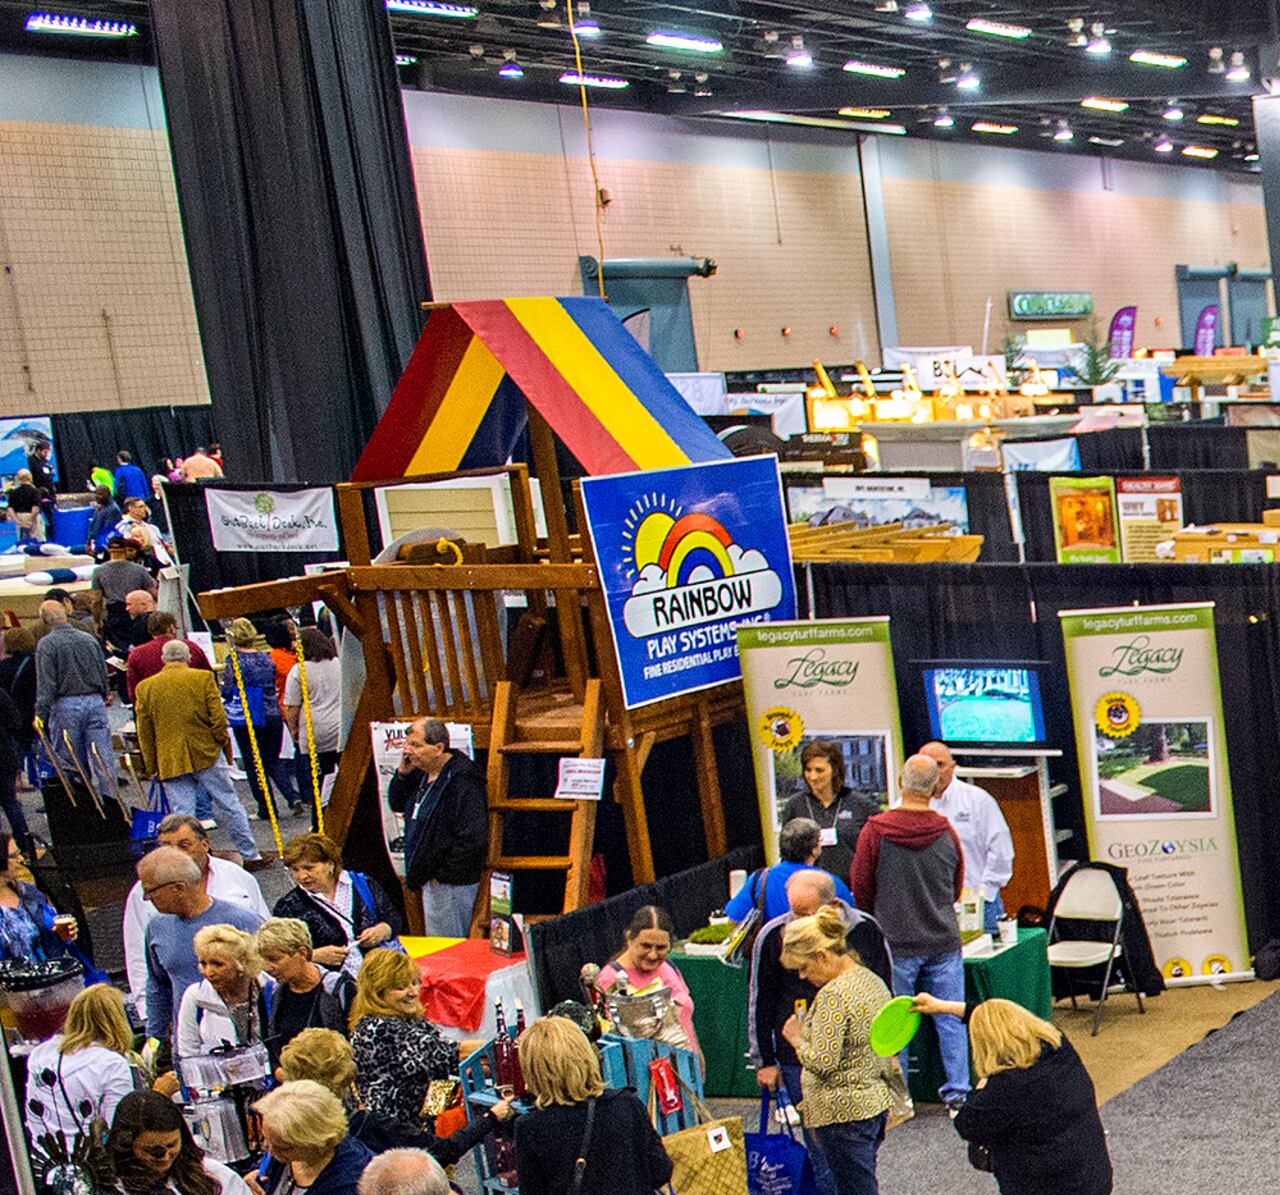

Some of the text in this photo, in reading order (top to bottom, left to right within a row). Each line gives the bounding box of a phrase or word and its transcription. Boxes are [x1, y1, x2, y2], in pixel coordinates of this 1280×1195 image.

[652, 579, 752, 627] RAINBOW
[646, 634, 677, 660] PLAY
[773, 647, 860, 689] Legacy
[1099, 635, 1184, 678] Legacy
